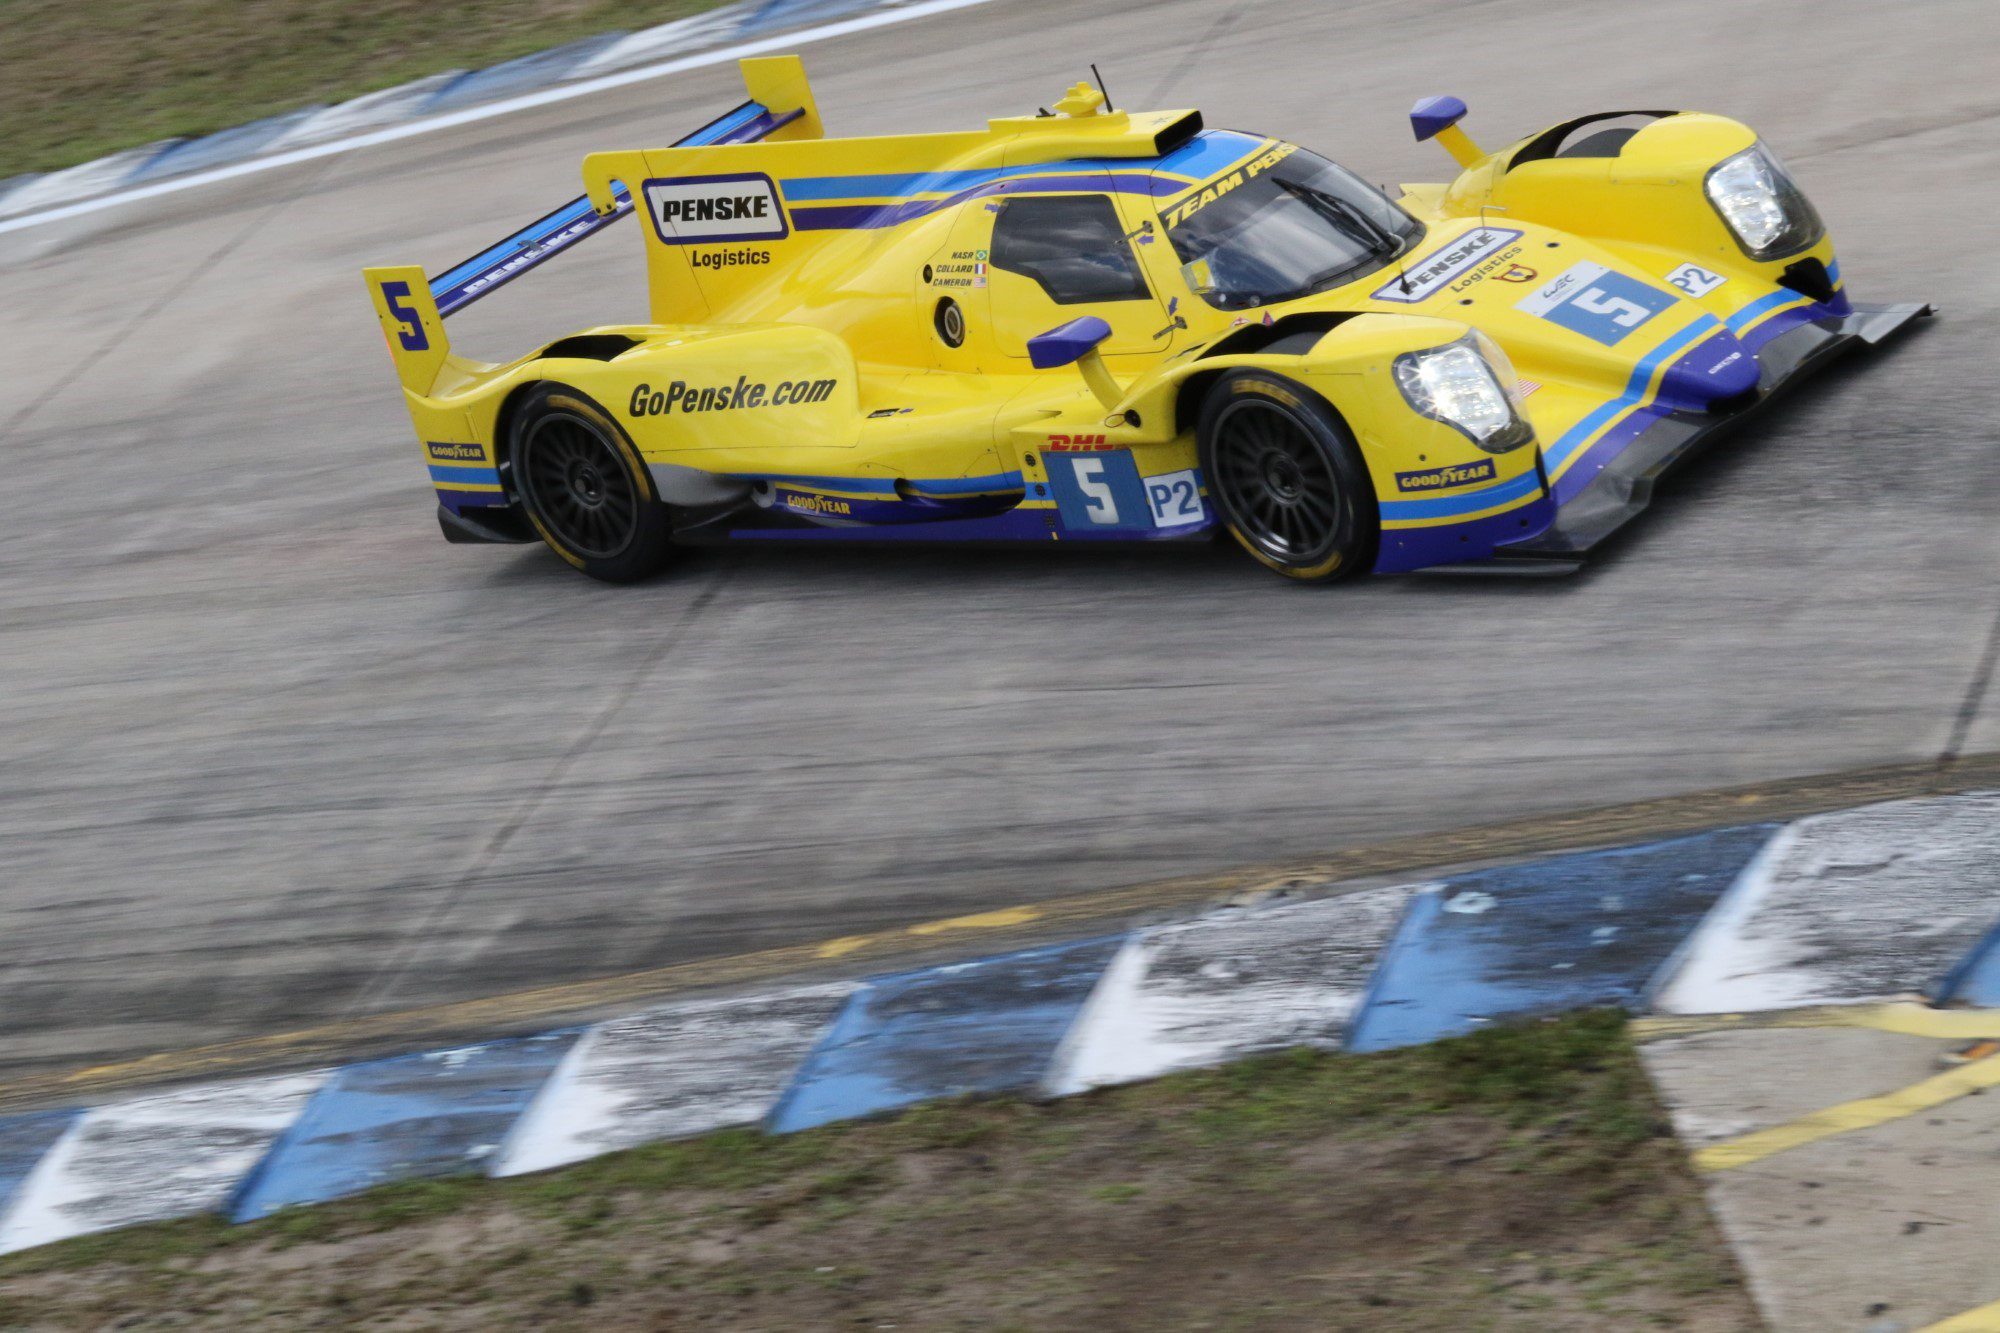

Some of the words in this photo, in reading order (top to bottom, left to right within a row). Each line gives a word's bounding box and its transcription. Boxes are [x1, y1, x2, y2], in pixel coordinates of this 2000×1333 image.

[663, 195, 768, 223] PENSKE
[1165, 172, 1244, 231] TEAM
[692, 247, 770, 270] Logistics
[936, 264, 973, 273] COLLARD
[951, 251, 974, 260] NASR
[932, 278, 973, 287] CAMERON
[1450, 246, 1522, 293] Logistics
[1670, 268, 1718, 295] P2
[380, 281, 430, 351] 5
[1569, 287, 1651, 327] 5
[629, 375, 837, 418] GoPenske.com
[431, 445, 482, 459] GOODYEAR
[1042, 434, 1114, 452] DHL
[1401, 465, 1490, 488] GOODYEAR
[1071, 457, 1120, 524] 5
[1149, 480, 1199, 518] P2
[787, 495, 851, 515] GOODYEAR
